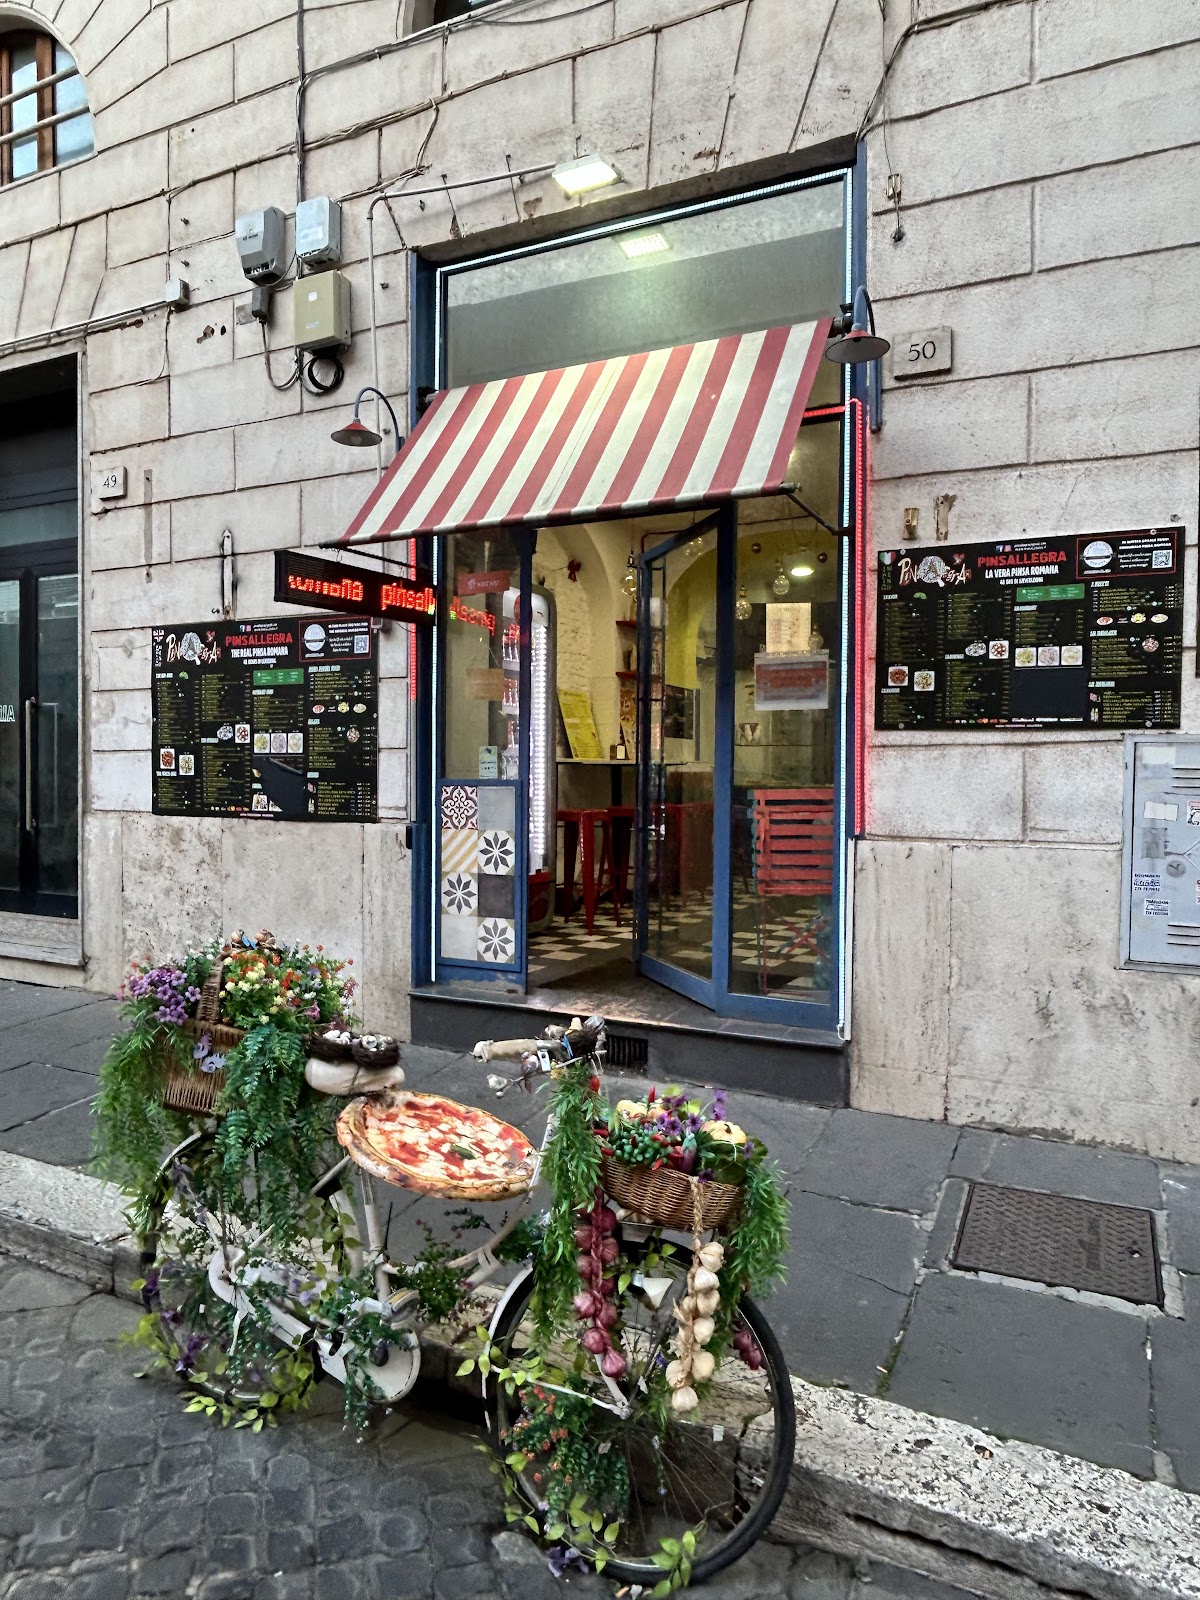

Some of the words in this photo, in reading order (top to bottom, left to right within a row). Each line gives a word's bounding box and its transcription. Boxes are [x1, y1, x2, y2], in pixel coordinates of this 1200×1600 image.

[908, 341, 936, 361] 50
[102, 475, 117, 488] 49
[977, 551, 1067, 568] PINSALLEGRA
[994, 568, 1011, 579] VERA
[1011, 566, 1030, 577] PINSA
[1030, 565, 1059, 576] ROMANA
[225, 632, 294, 647] PINSALLEGRA
